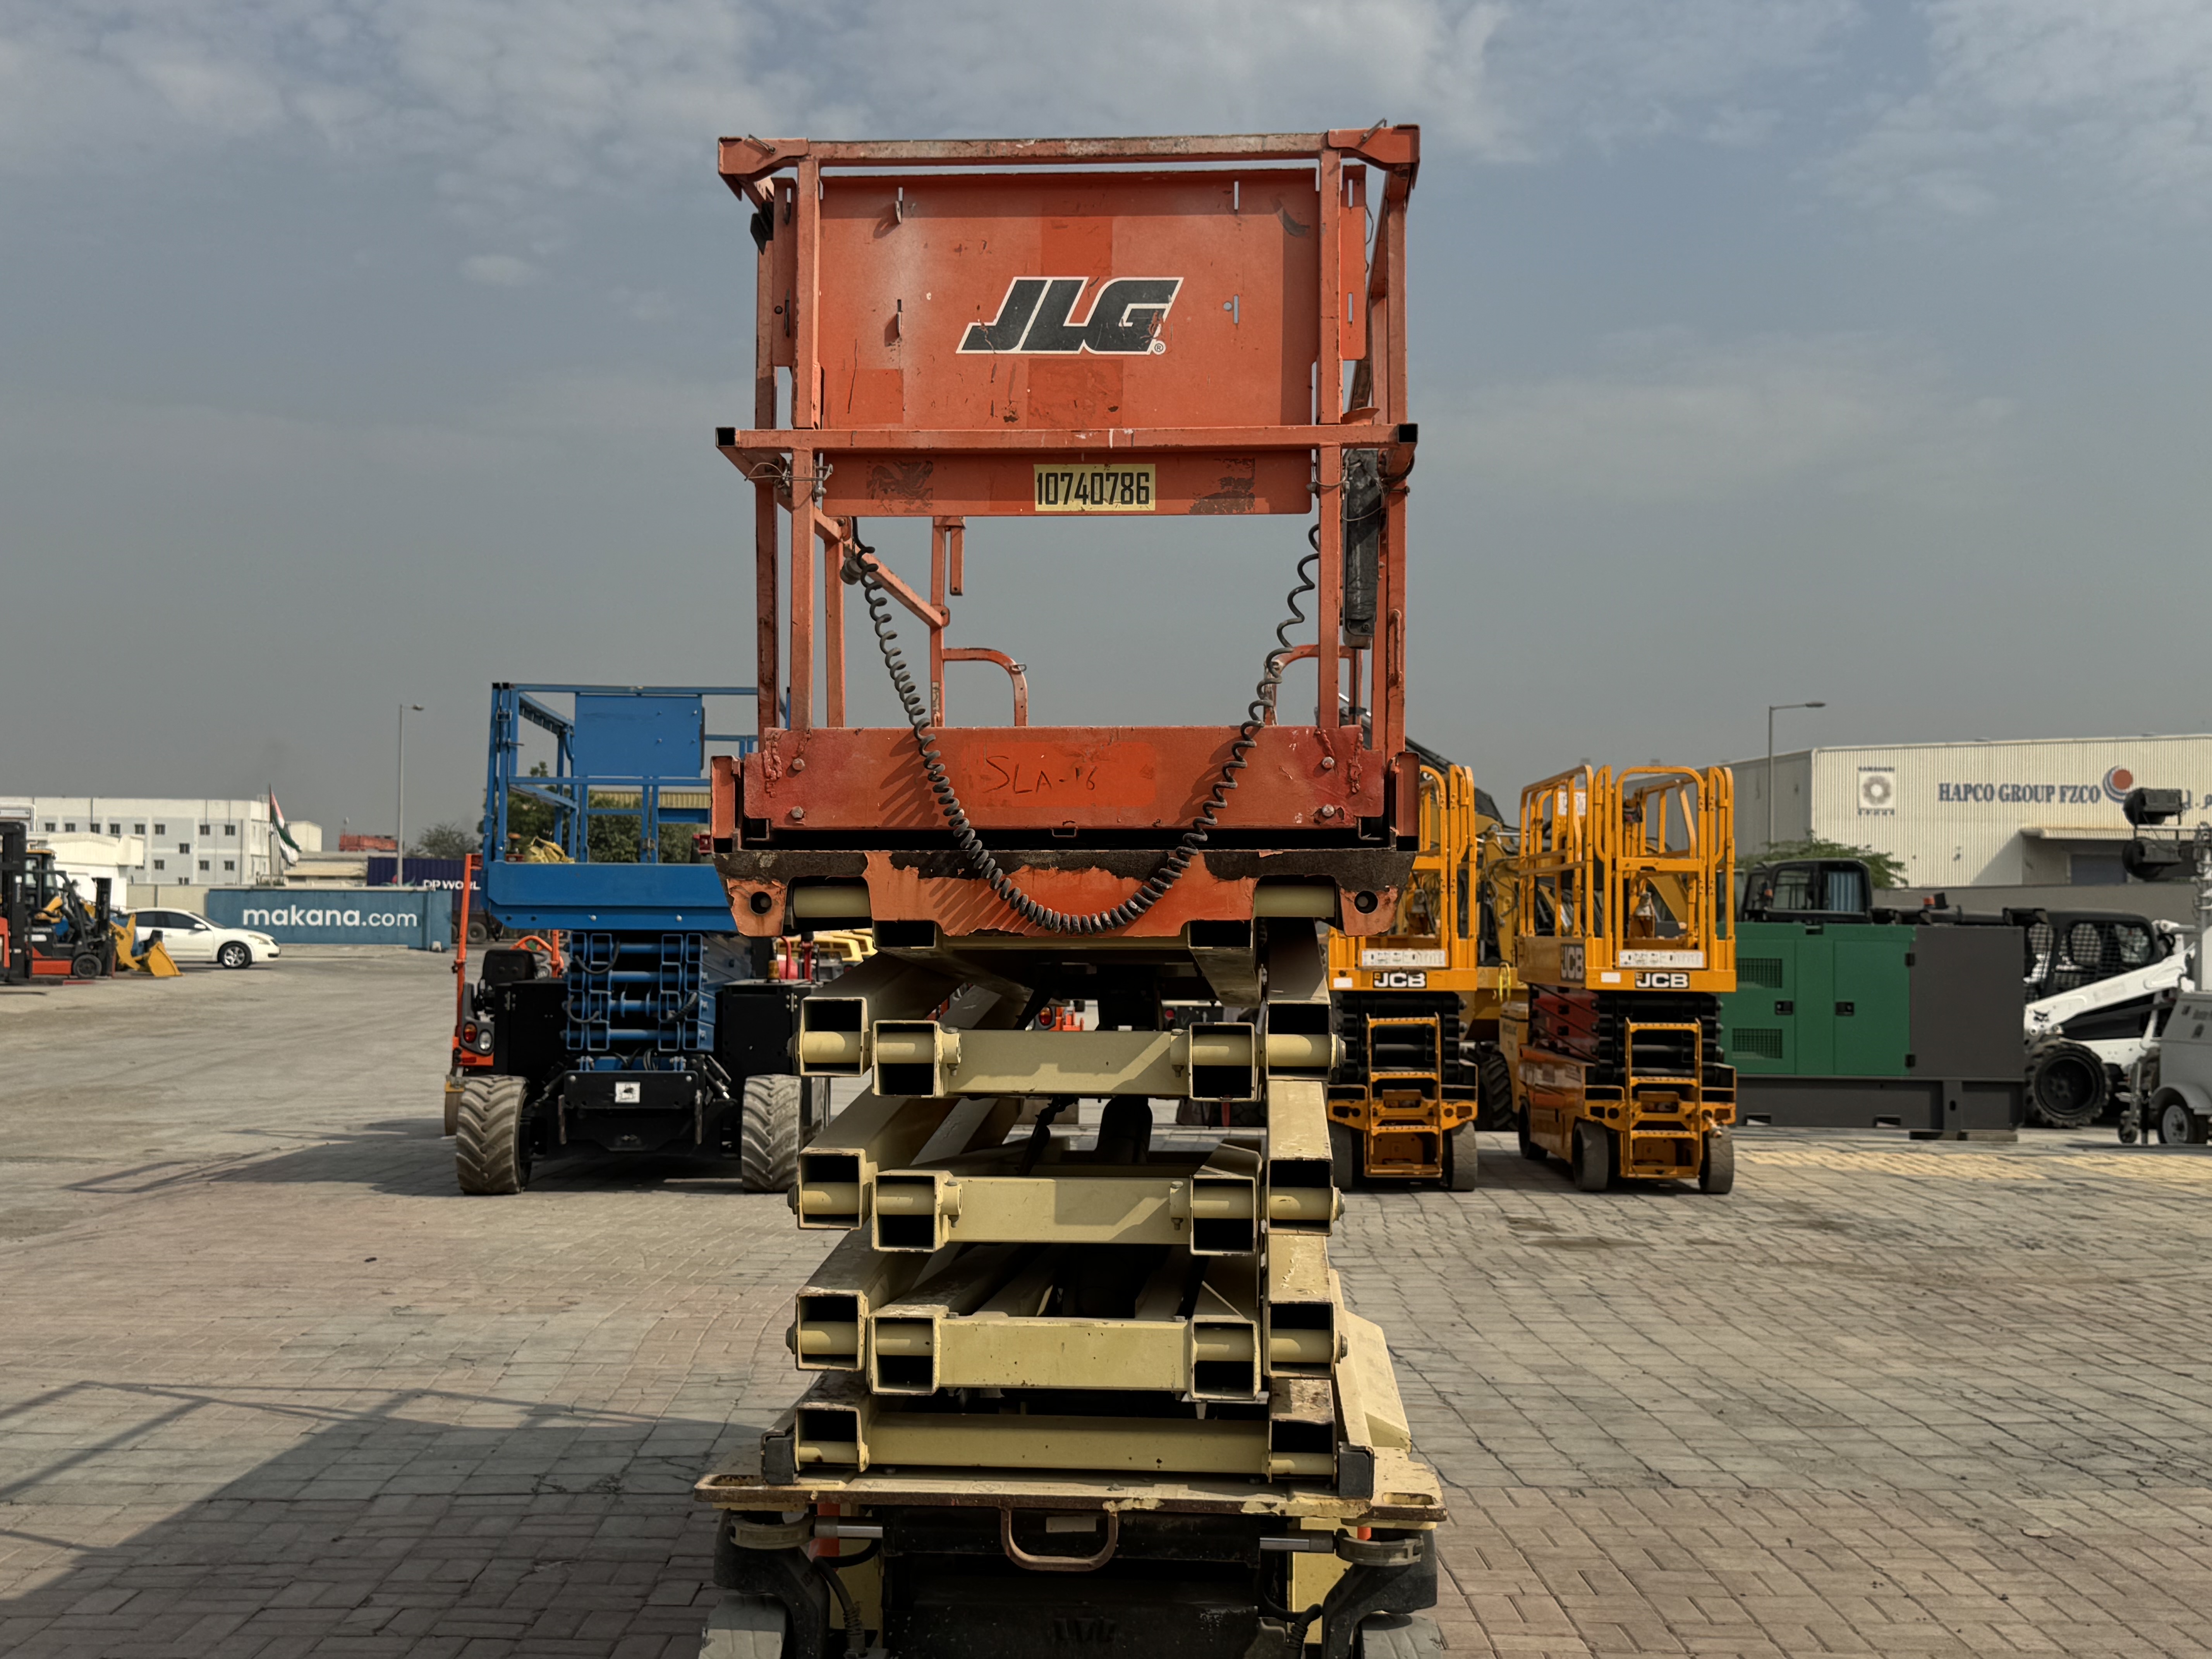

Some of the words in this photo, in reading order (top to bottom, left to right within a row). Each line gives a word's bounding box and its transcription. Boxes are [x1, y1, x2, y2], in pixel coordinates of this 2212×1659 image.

[956, 276, 1184, 354] JLG
[1037, 472, 1149, 505] 10740786
[1939, 783, 1995, 802] HAPCO
[1998, 783, 2055, 803] GROUP
[2059, 785, 2101, 803] FZCO
[243, 905, 417, 927] makana.com
[1561, 946, 1584, 979] JCB
[1374, 972, 1425, 987] JCB
[1636, 973, 1688, 988] JCB
